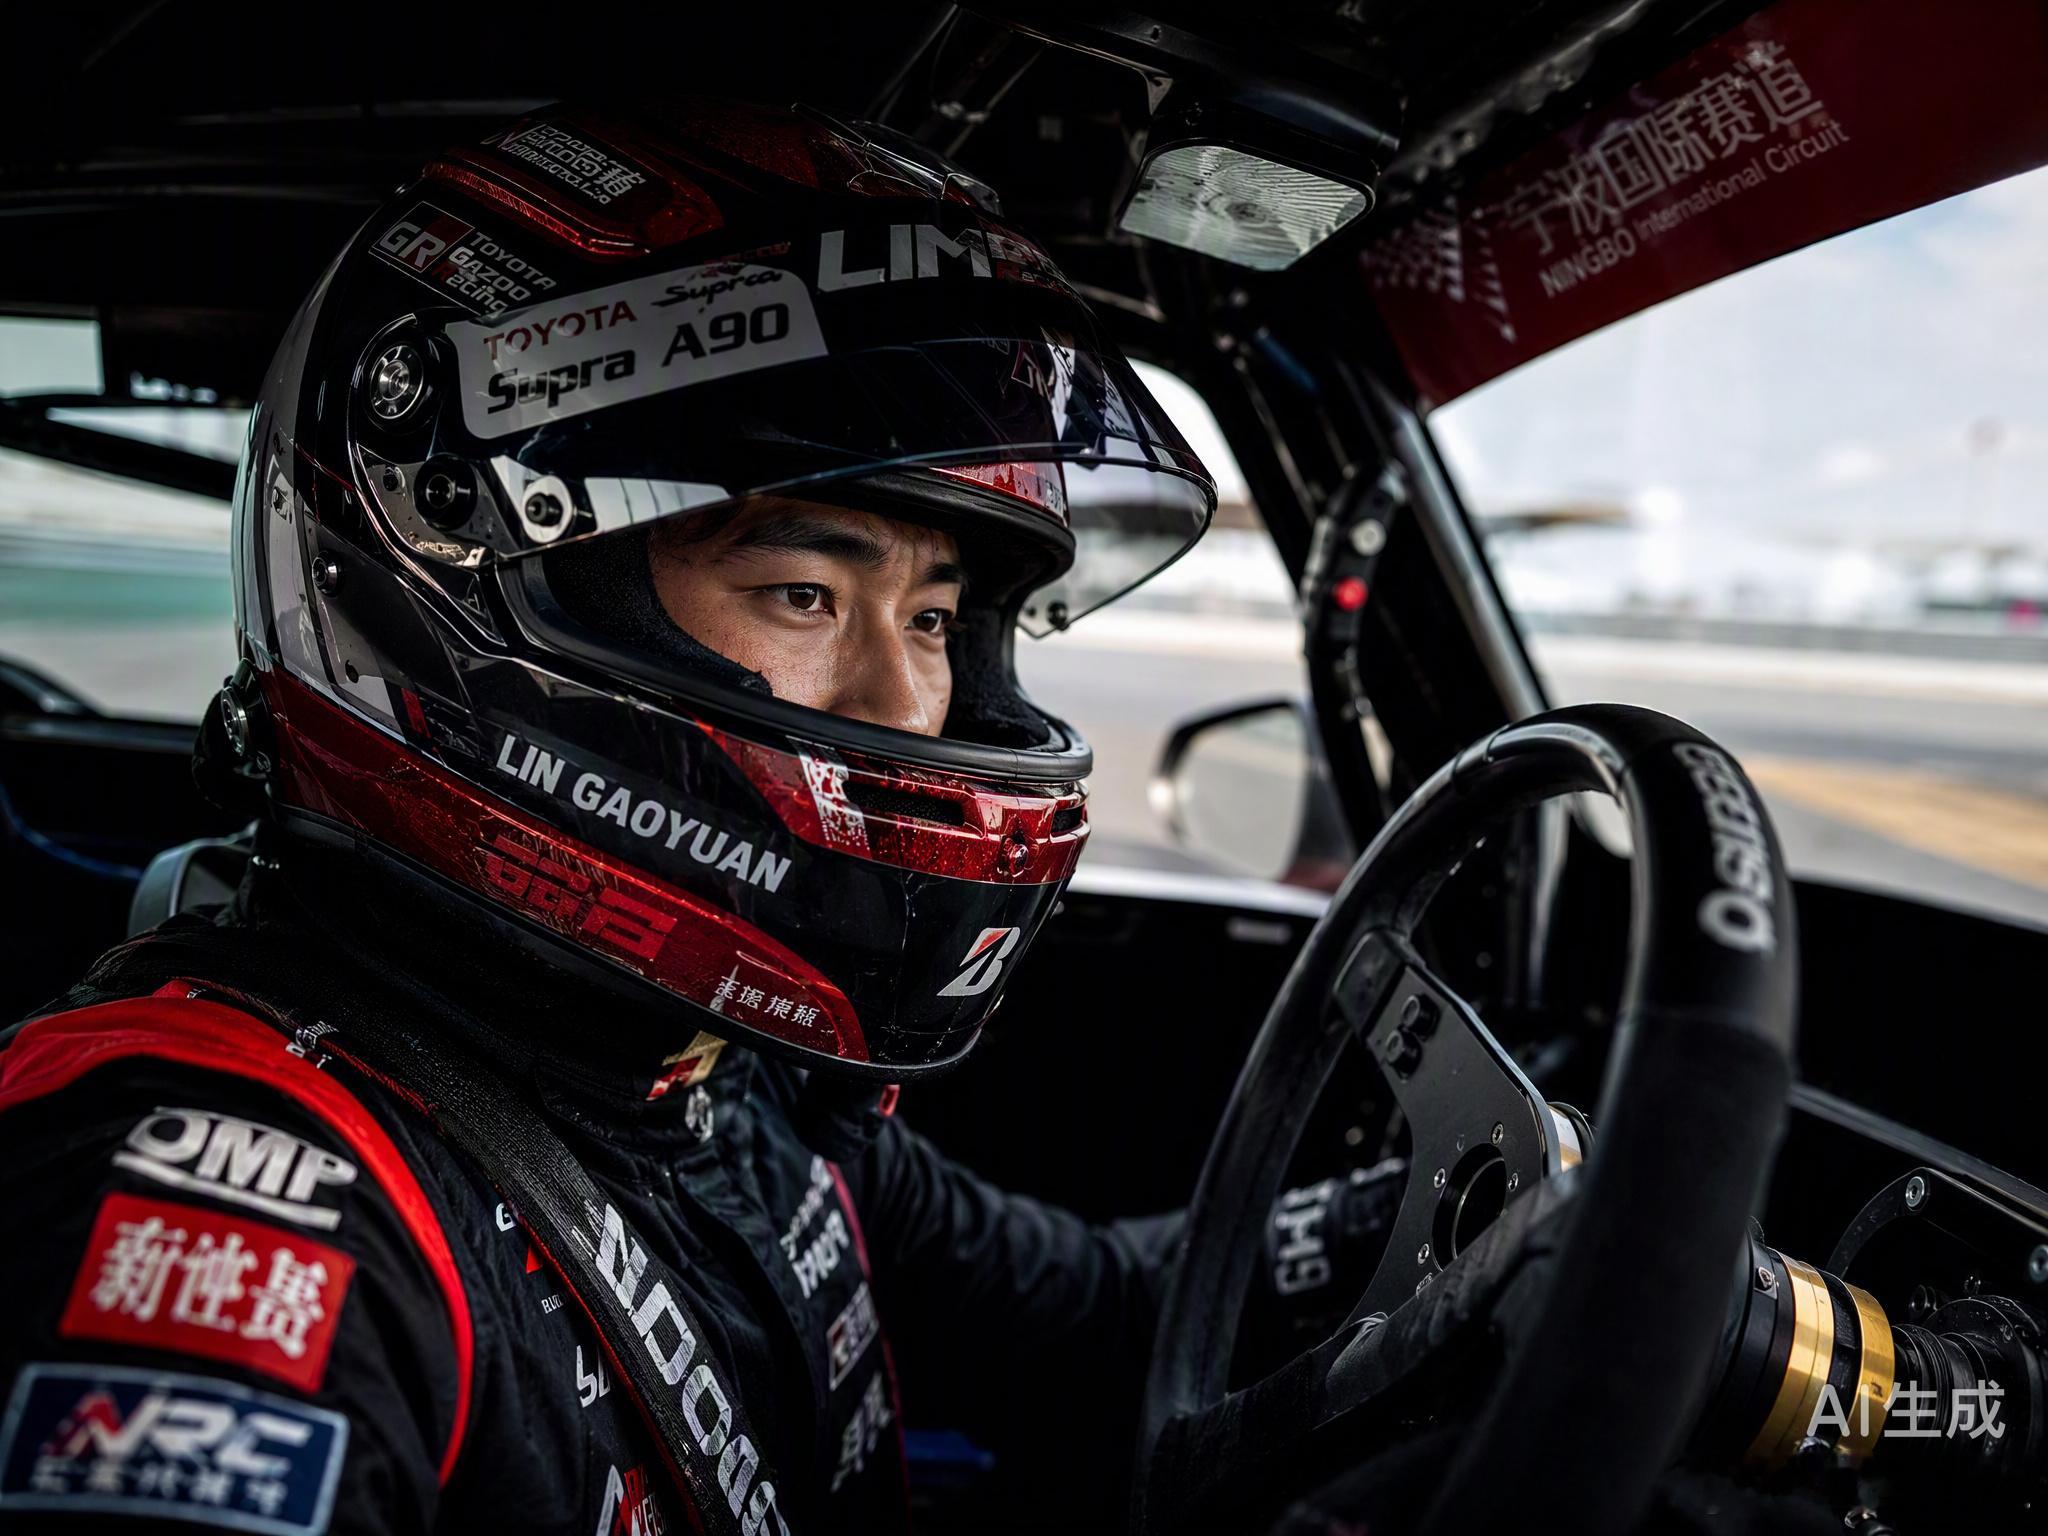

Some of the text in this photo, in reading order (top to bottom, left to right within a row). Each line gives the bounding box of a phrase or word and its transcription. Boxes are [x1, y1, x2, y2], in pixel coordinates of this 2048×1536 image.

[379, 221, 447, 268] GR
[1538, 226, 1637, 299] NINGBO
[1763, 118, 1851, 175] Circuit
[448, 246, 532, 301] GAZOO
[468, 231, 558, 291] TOYOTA
[483, 300, 638, 361] TOYOTA
[487, 302, 789, 414] Supra A90
[496, 733, 565, 795] LIN
[571, 771, 793, 894] GAOYUAN
[125, 1105, 358, 1203] OMP
